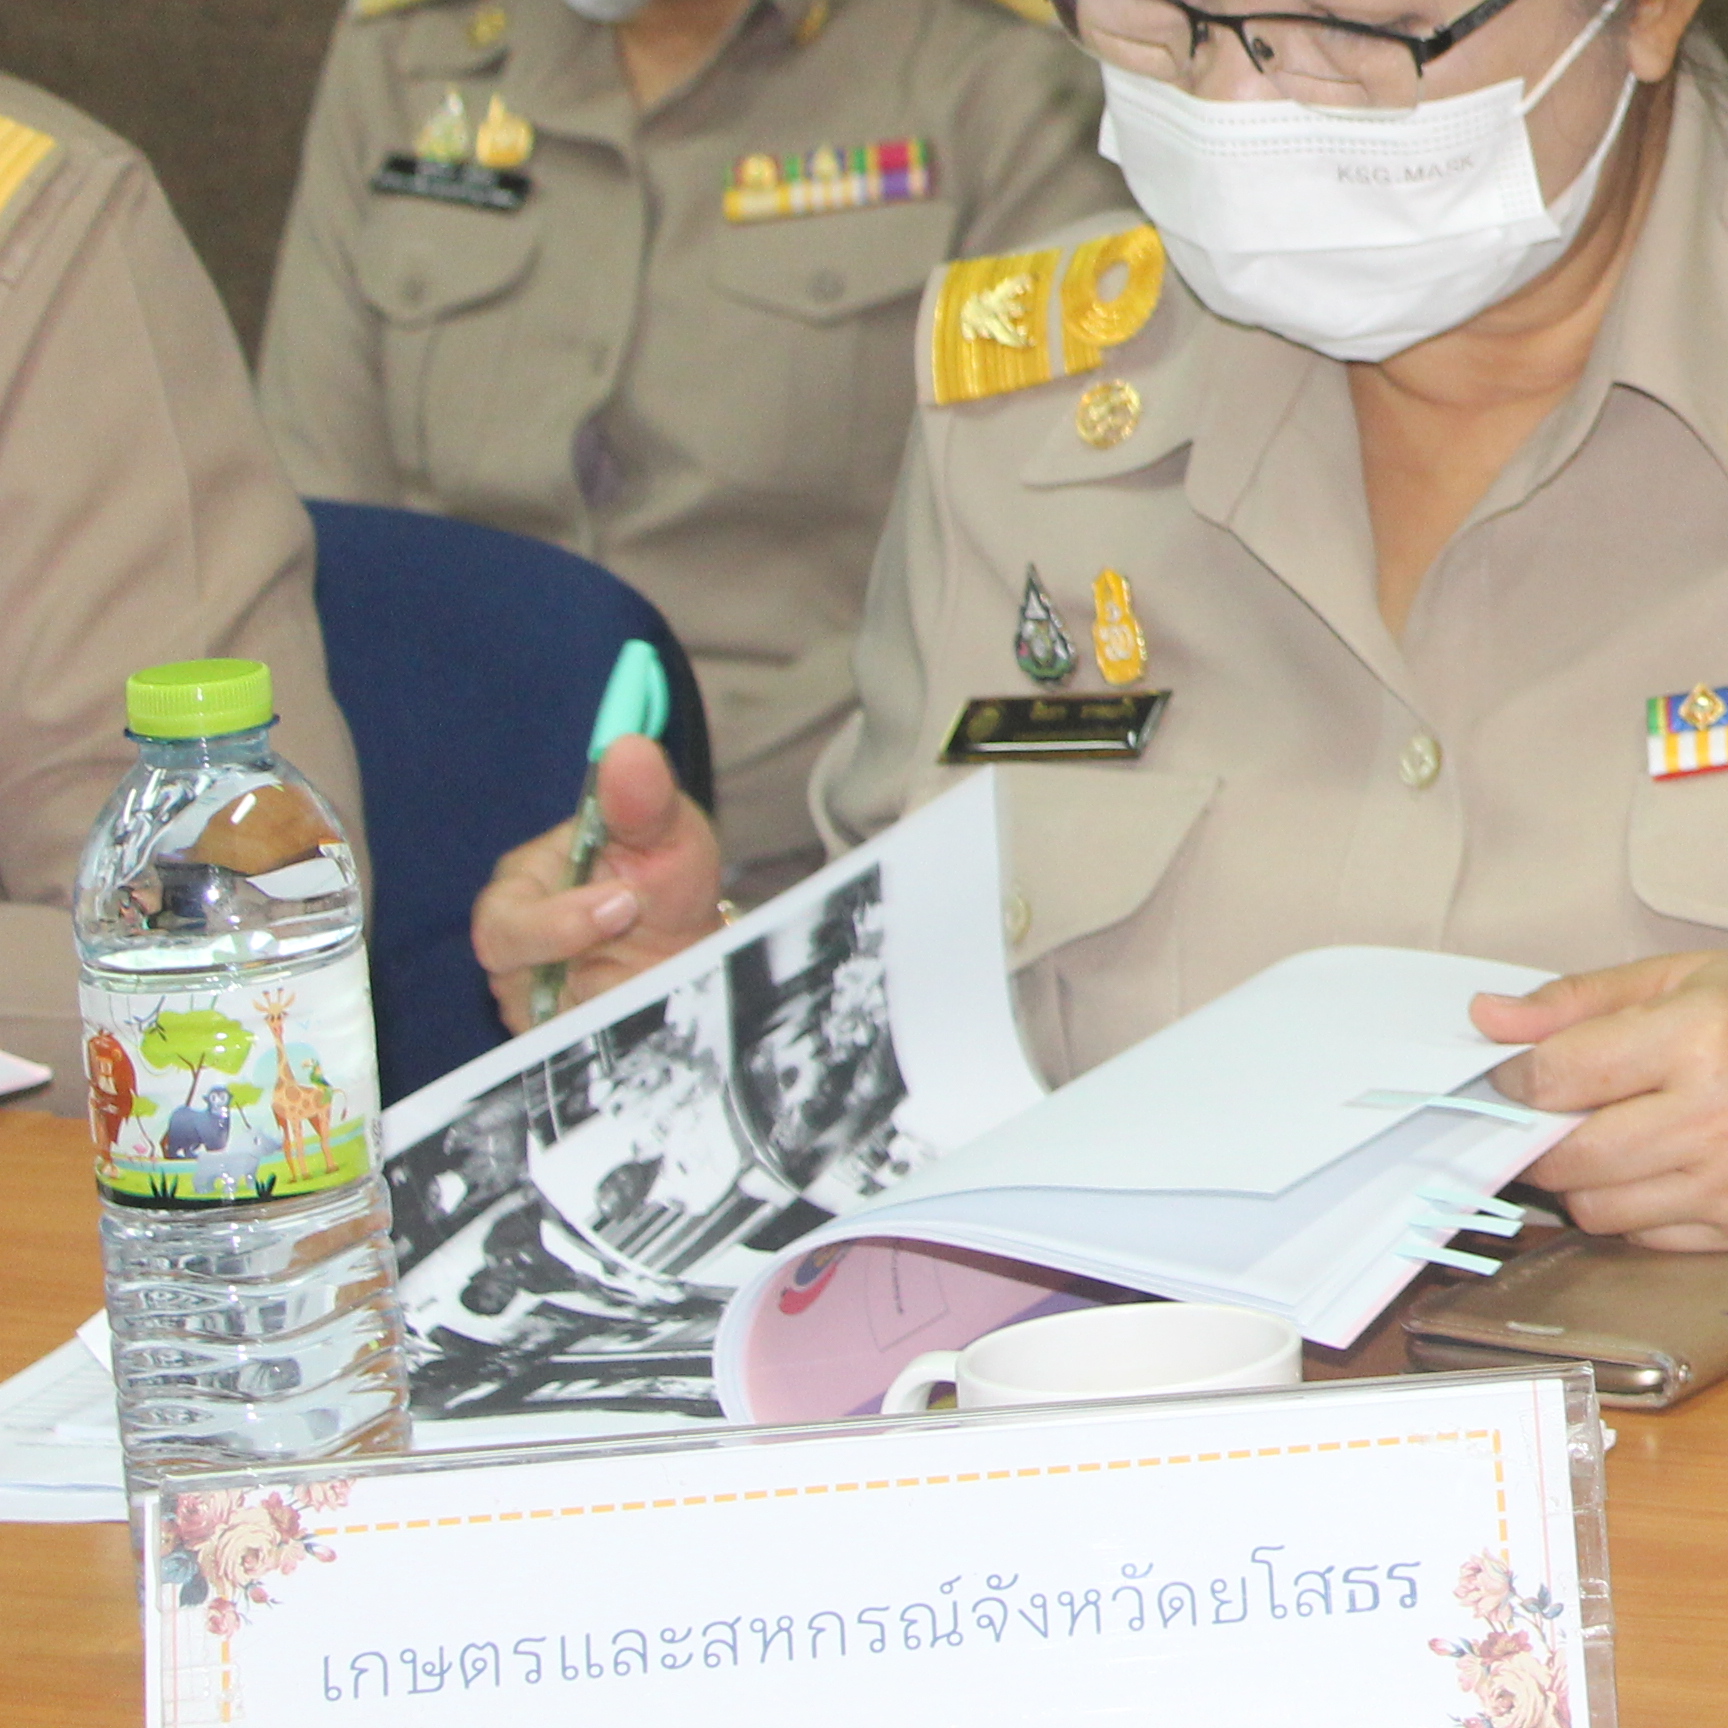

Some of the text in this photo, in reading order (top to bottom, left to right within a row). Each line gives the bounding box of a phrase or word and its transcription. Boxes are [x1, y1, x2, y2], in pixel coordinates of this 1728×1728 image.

[322, 1544, 1421, 1701] เกษตรและสหกรณ์จังหวัดยโสธร
